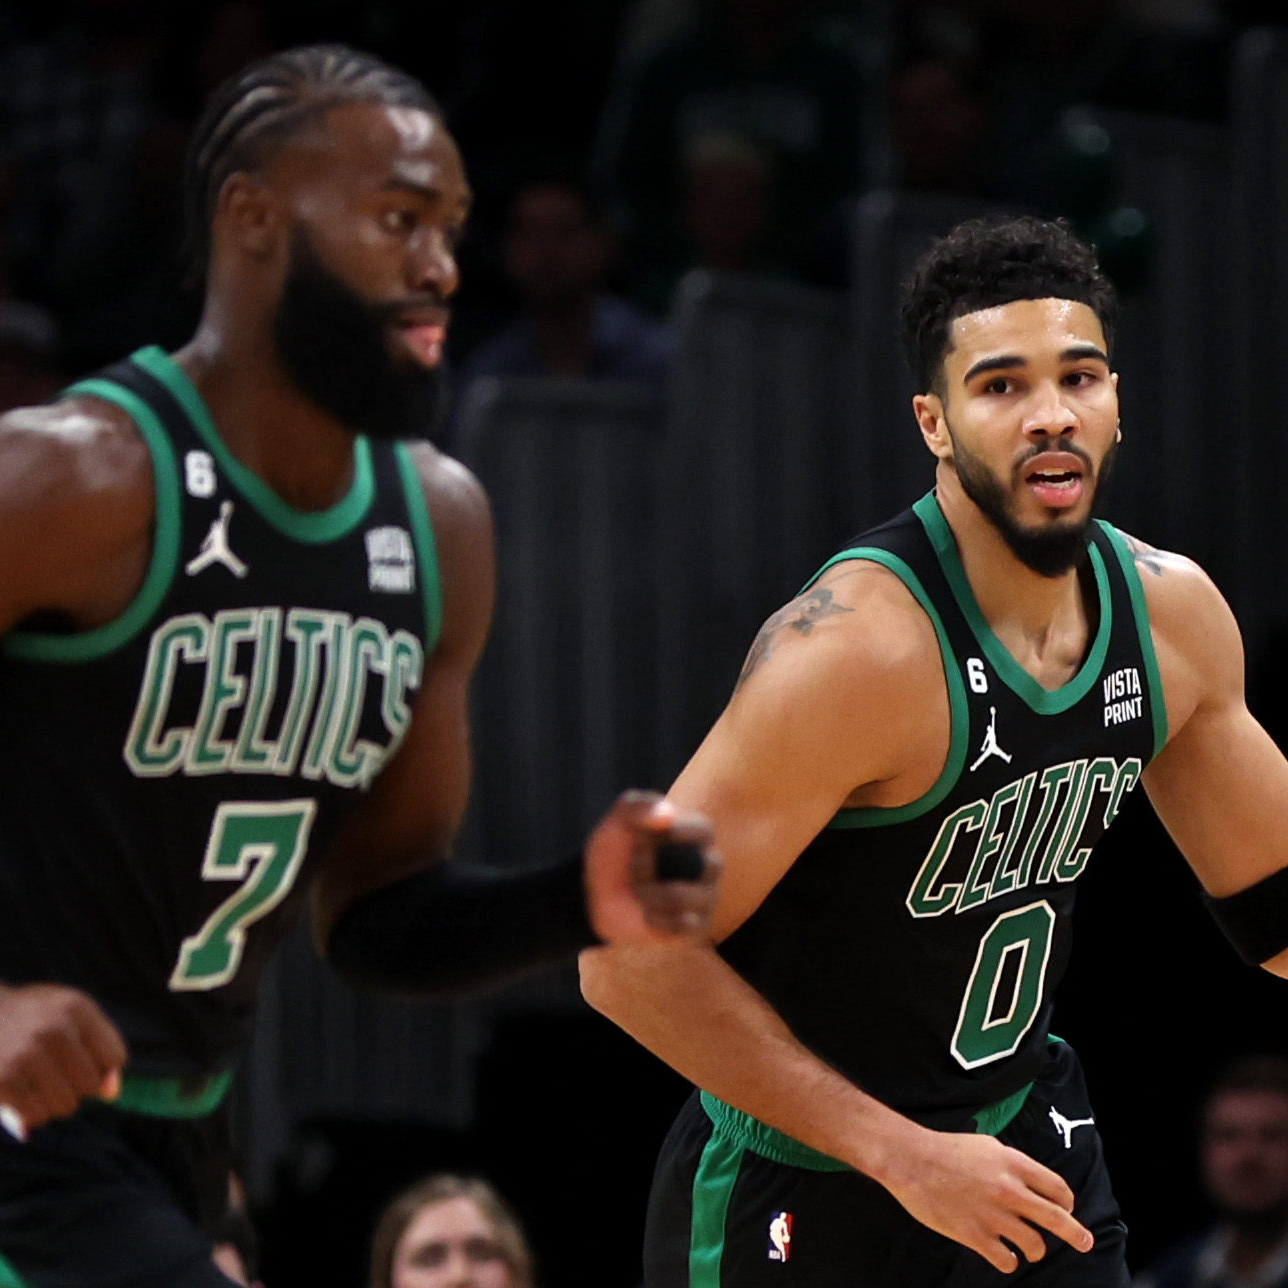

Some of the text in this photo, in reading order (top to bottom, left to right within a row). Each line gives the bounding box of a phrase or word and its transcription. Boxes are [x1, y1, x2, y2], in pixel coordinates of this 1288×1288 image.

[184, 449, 217, 498] 6
[124, 606, 424, 792] CELTICS
[965, 657, 989, 694] 6
[1103, 667, 1142, 705] VISTA
[1104, 696, 1143, 728] PRINT
[169, 797, 317, 991] 7
[950, 899, 1056, 1070] 0
